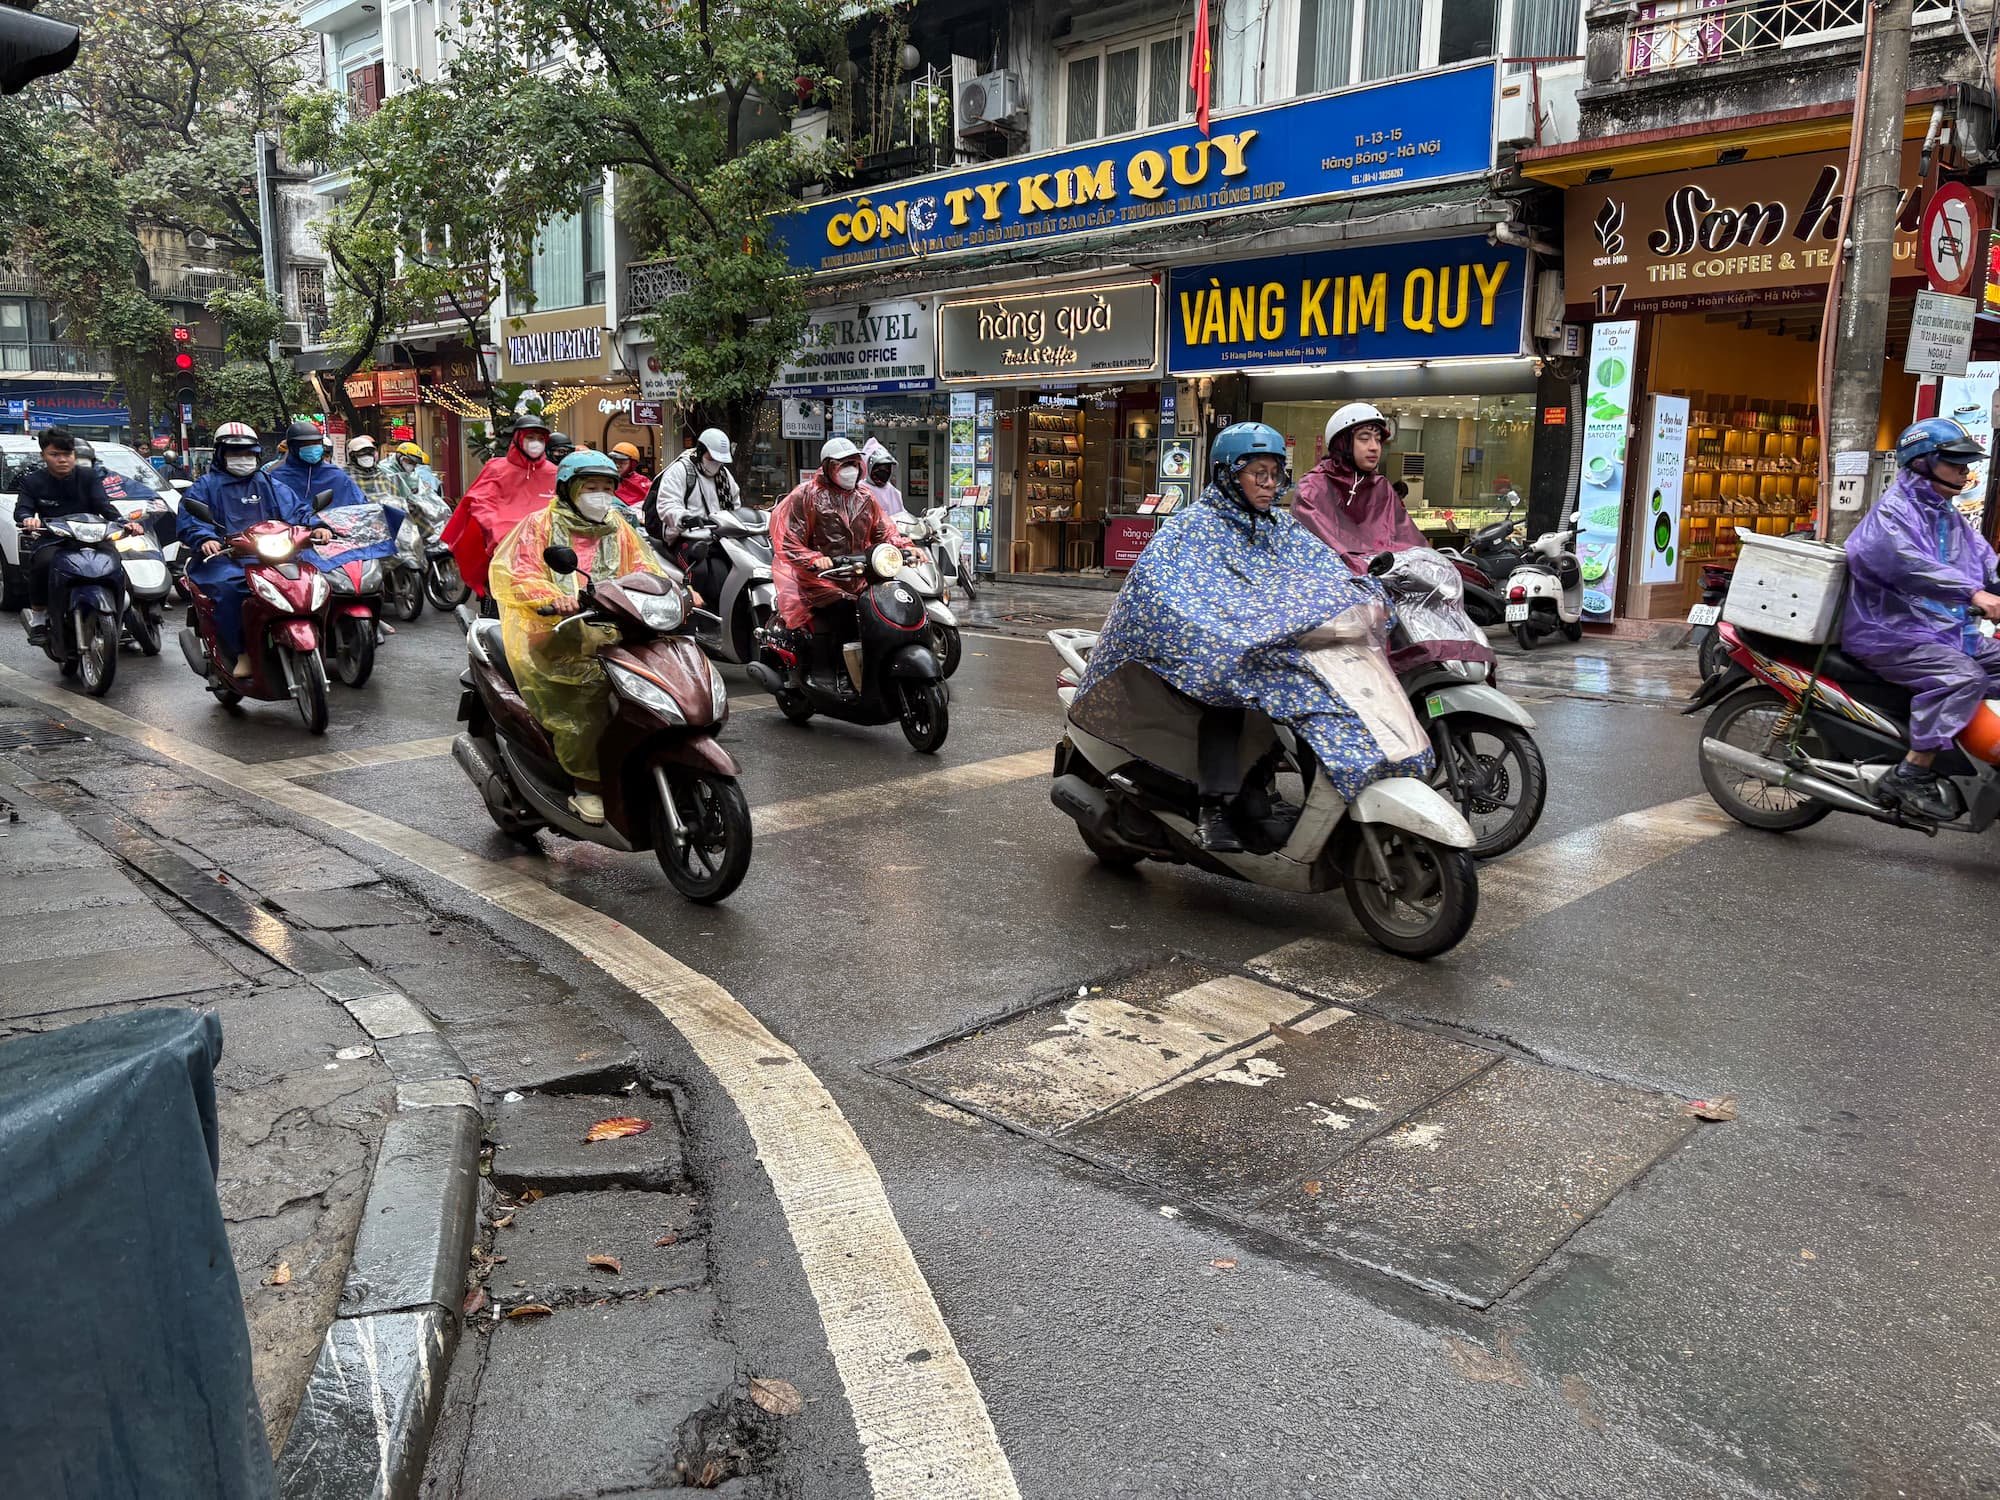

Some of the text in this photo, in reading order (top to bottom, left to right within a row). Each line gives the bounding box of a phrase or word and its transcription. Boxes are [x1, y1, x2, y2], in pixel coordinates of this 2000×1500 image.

[1321, 155, 1354, 171] Hàng
[1355, 150, 1388, 166] Bông
[1397, 143, 1416, 158] Hà
[1417, 139, 1441, 156] Nội
[826, 129, 1259, 247] CÔNG TY KIM QUY
[1208, 183, 1251, 207] TỔNG
[1646, 262, 1688, 283] THE
[1691, 254, 1773, 279] COFFEE
[1777, 252, 1796, 270] &
[1179, 260, 1511, 346] VÀNG KIM QUY
[1591, 283, 1628, 317] 17
[1633, 300, 1659, 312] Hàng
[1661, 298, 1688, 311] Bông
[1697, 294, 1724, 307] Hoàn
[1727, 291, 1755, 305] Kiếm
[1764, 291, 1779, 301] Hà
[977, 293, 1112, 345] hàng quà
[173, 327, 189, 340] 26
[858, 347, 897, 364] OFFICE
[1221, 351, 1230, 360] 15
[1230, 349, 1247, 361] Hàng
[1247, 348, 1264, 360] Bông
[1267, 347, 1284, 359] Hoàn
[1305, 347, 1315, 357] Hà
[908, 364, 925, 377] TOUR
[1164, 398, 1174, 408] 13
[797, 422, 822, 431] TRAVEL
[1219, 416, 1228, 427] 15
[1656, 451, 1680, 466] MATCHA
[1839, 480, 1857, 491] NT
[1122, 526, 1154, 540] hàng qu
